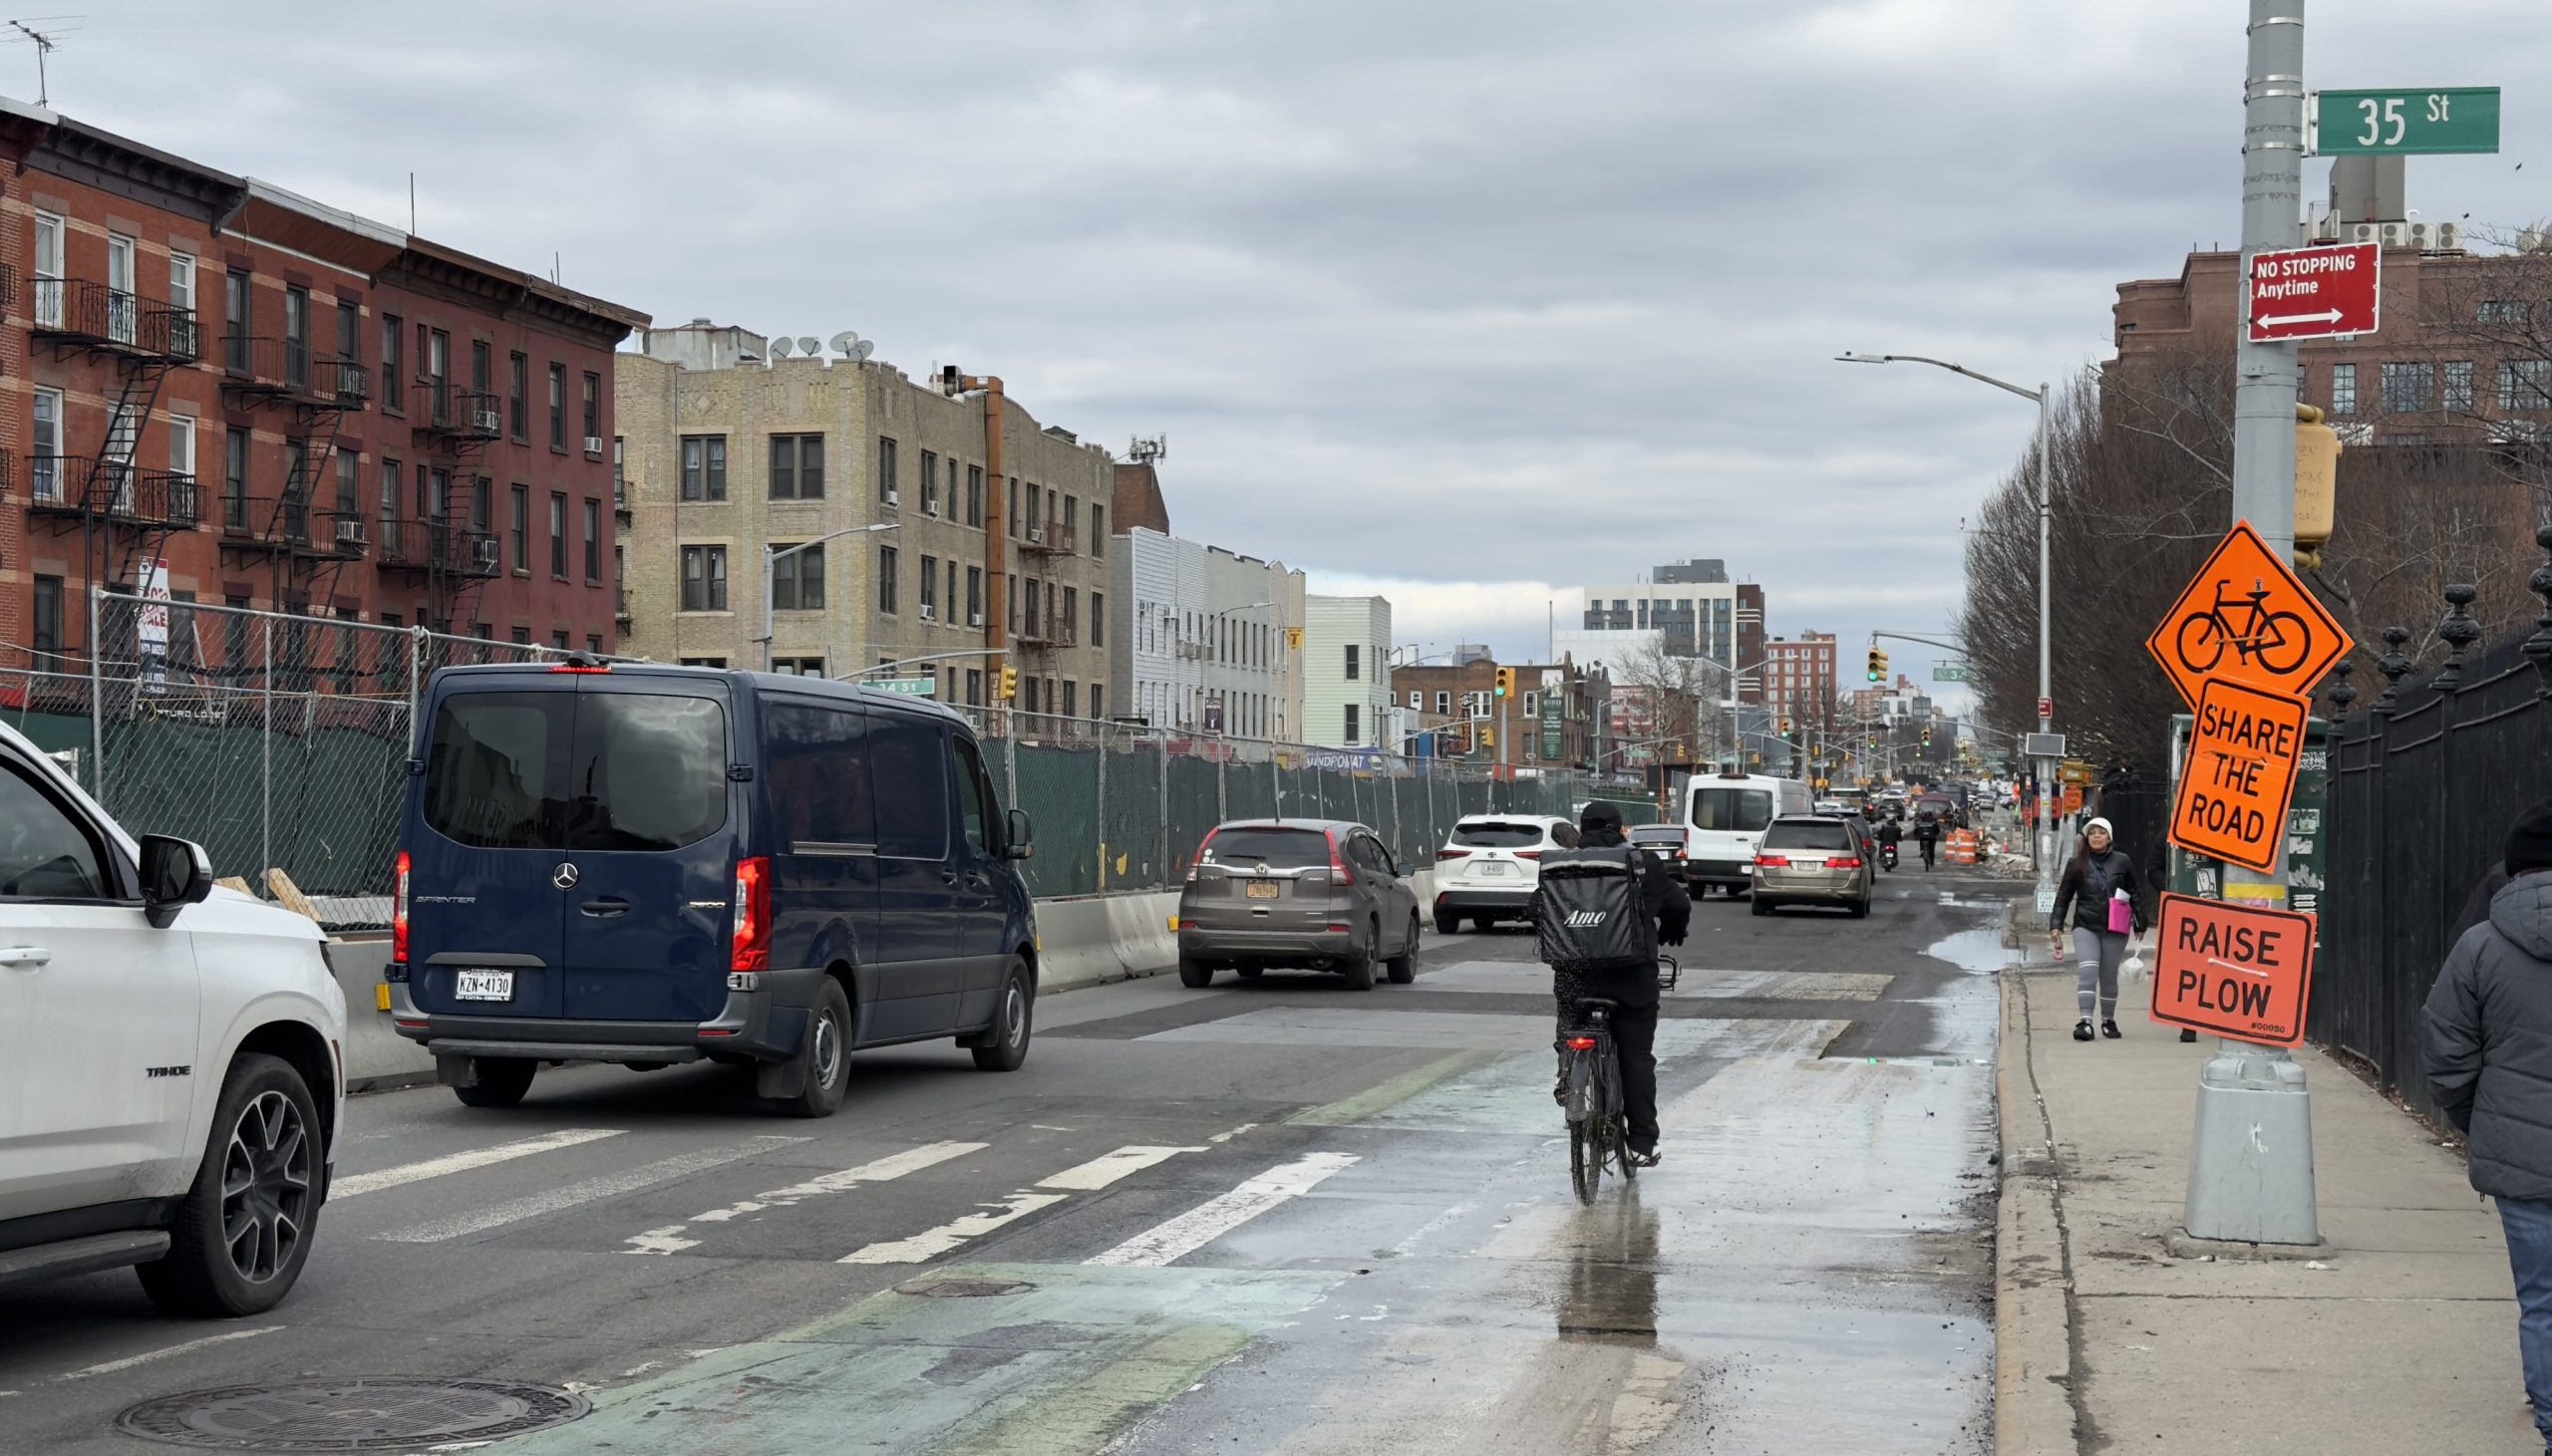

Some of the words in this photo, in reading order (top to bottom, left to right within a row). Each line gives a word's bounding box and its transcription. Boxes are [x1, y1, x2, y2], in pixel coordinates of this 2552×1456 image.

[2357, 99, 2405, 146] 35
[2426, 94, 2450, 123] St
[2257, 261, 2279, 279] NO
[2282, 254, 2356, 277] STOPPING
[2257, 279, 2319, 300] Anytime
[901, 682, 916, 693] St
[2201, 703, 2295, 758] SHARE
[2213, 752, 2265, 797] THE
[2188, 792, 2265, 843] ROAD
[1563, 910, 1607, 925] Amo
[2178, 916, 2282, 967] RAISE
[2177, 969, 2272, 1019] PLOW
[146, 1064, 191, 1077] TAHOE
